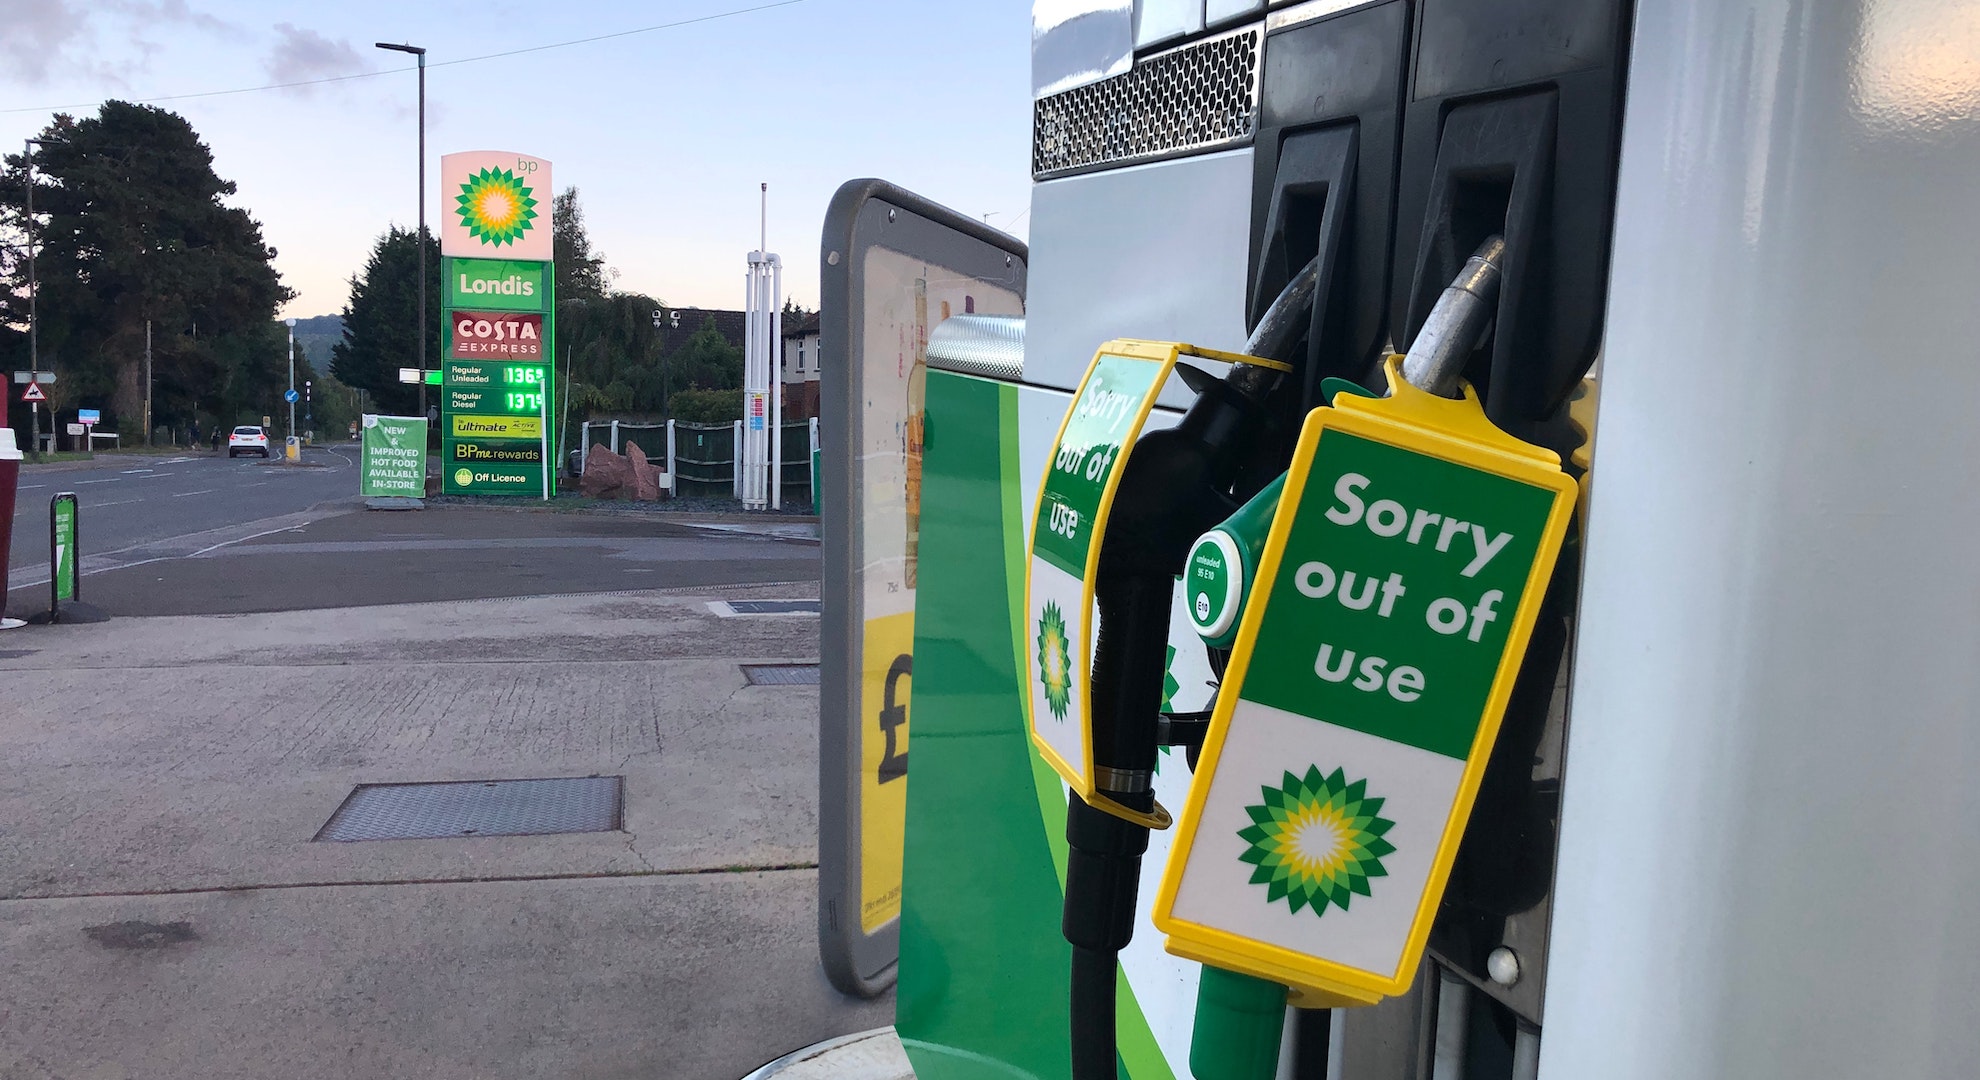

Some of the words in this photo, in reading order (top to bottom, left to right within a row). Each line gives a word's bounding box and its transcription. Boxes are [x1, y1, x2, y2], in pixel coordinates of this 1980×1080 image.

[517, 157, 538, 174] bp
[460, 273, 534, 296] Londis
[458, 319, 537, 341] COSTA
[470, 342, 537, 354] EXPRESS
[452, 365, 482, 375] Regular
[452, 374, 490, 383] Unleaded
[452, 391, 482, 401] Regular
[452, 400, 476, 408] Diesel
[1080, 377, 1137, 434] Sorry
[457, 422, 507, 432] ultimate
[370, 448, 418, 456] IMPROVED
[493, 449, 540, 460] rewards
[371, 458, 390, 466] HOT
[392, 459, 417, 468] FOOD
[1056, 440, 1088, 476] out
[1086, 439, 1119, 483] of
[368, 469, 419, 479] AVAILABLE
[475, 473, 489, 482] Off
[491, 473, 526, 483] Licence
[372, 480, 415, 488] IN-STORE
[1049, 503, 1079, 540] use
[1324, 472, 1514, 578] Sorry
[1196, 556, 1220, 568] unleaded
[1204, 569, 1215, 580] E10
[1198, 601, 1208, 612] E10
[1294, 561, 1406, 618] out
[1425, 589, 1504, 643] of
[1313, 643, 1426, 702] use
